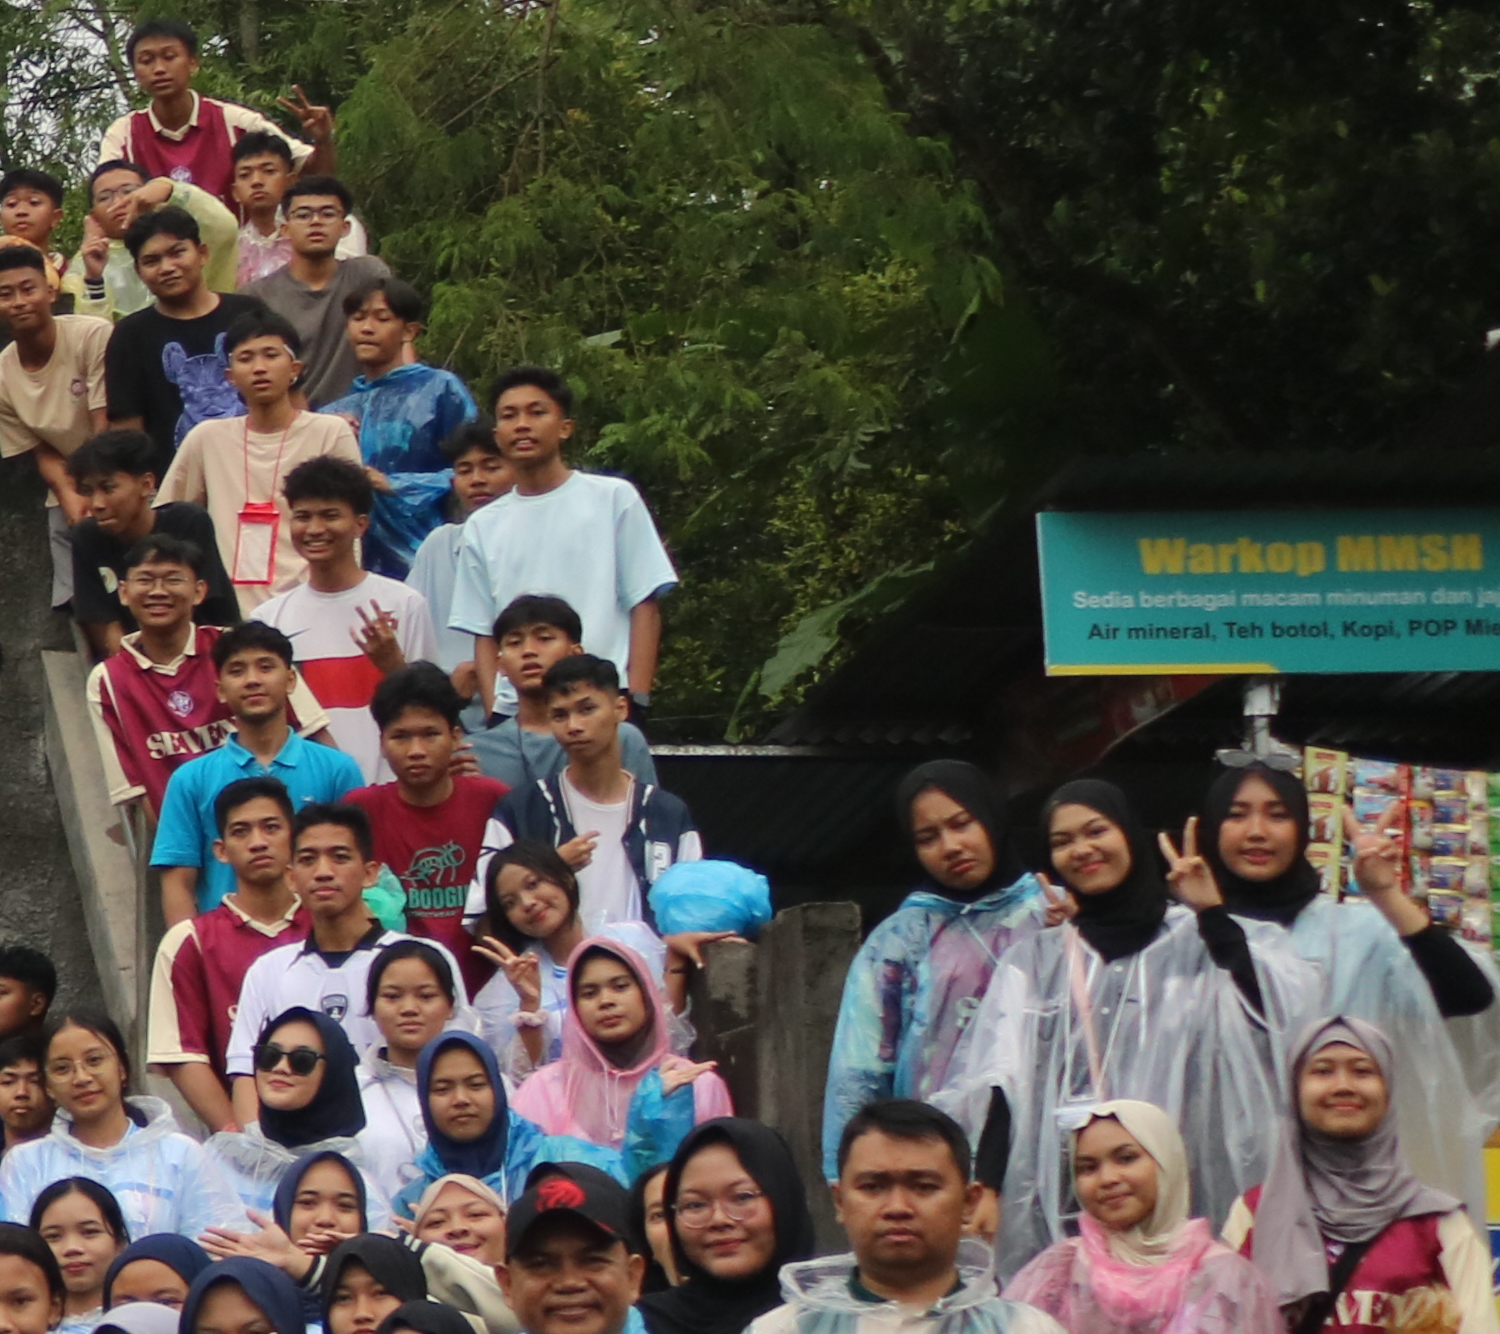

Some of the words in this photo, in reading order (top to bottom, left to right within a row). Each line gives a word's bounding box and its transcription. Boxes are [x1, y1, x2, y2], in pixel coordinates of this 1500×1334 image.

[1137, 536, 1326, 577] Warkop
[1335, 533, 1483, 572] MMSH
[1072, 590, 1135, 610] Sedia
[1139, 590, 1236, 611] berbagai
[1241, 592, 1322, 607] macam
[1326, 589, 1427, 605] minuman
[1432, 586, 1472, 604] dan
[1088, 623, 1120, 640] Air
[1127, 622, 1217, 642] mineral,
[1223, 622, 1264, 639] Teh
[1271, 620, 1335, 641] botol,
[1342, 620, 1402, 642] Kopi,
[1408, 619, 1458, 637] POP
[408, 885, 469, 909] BOOGI
